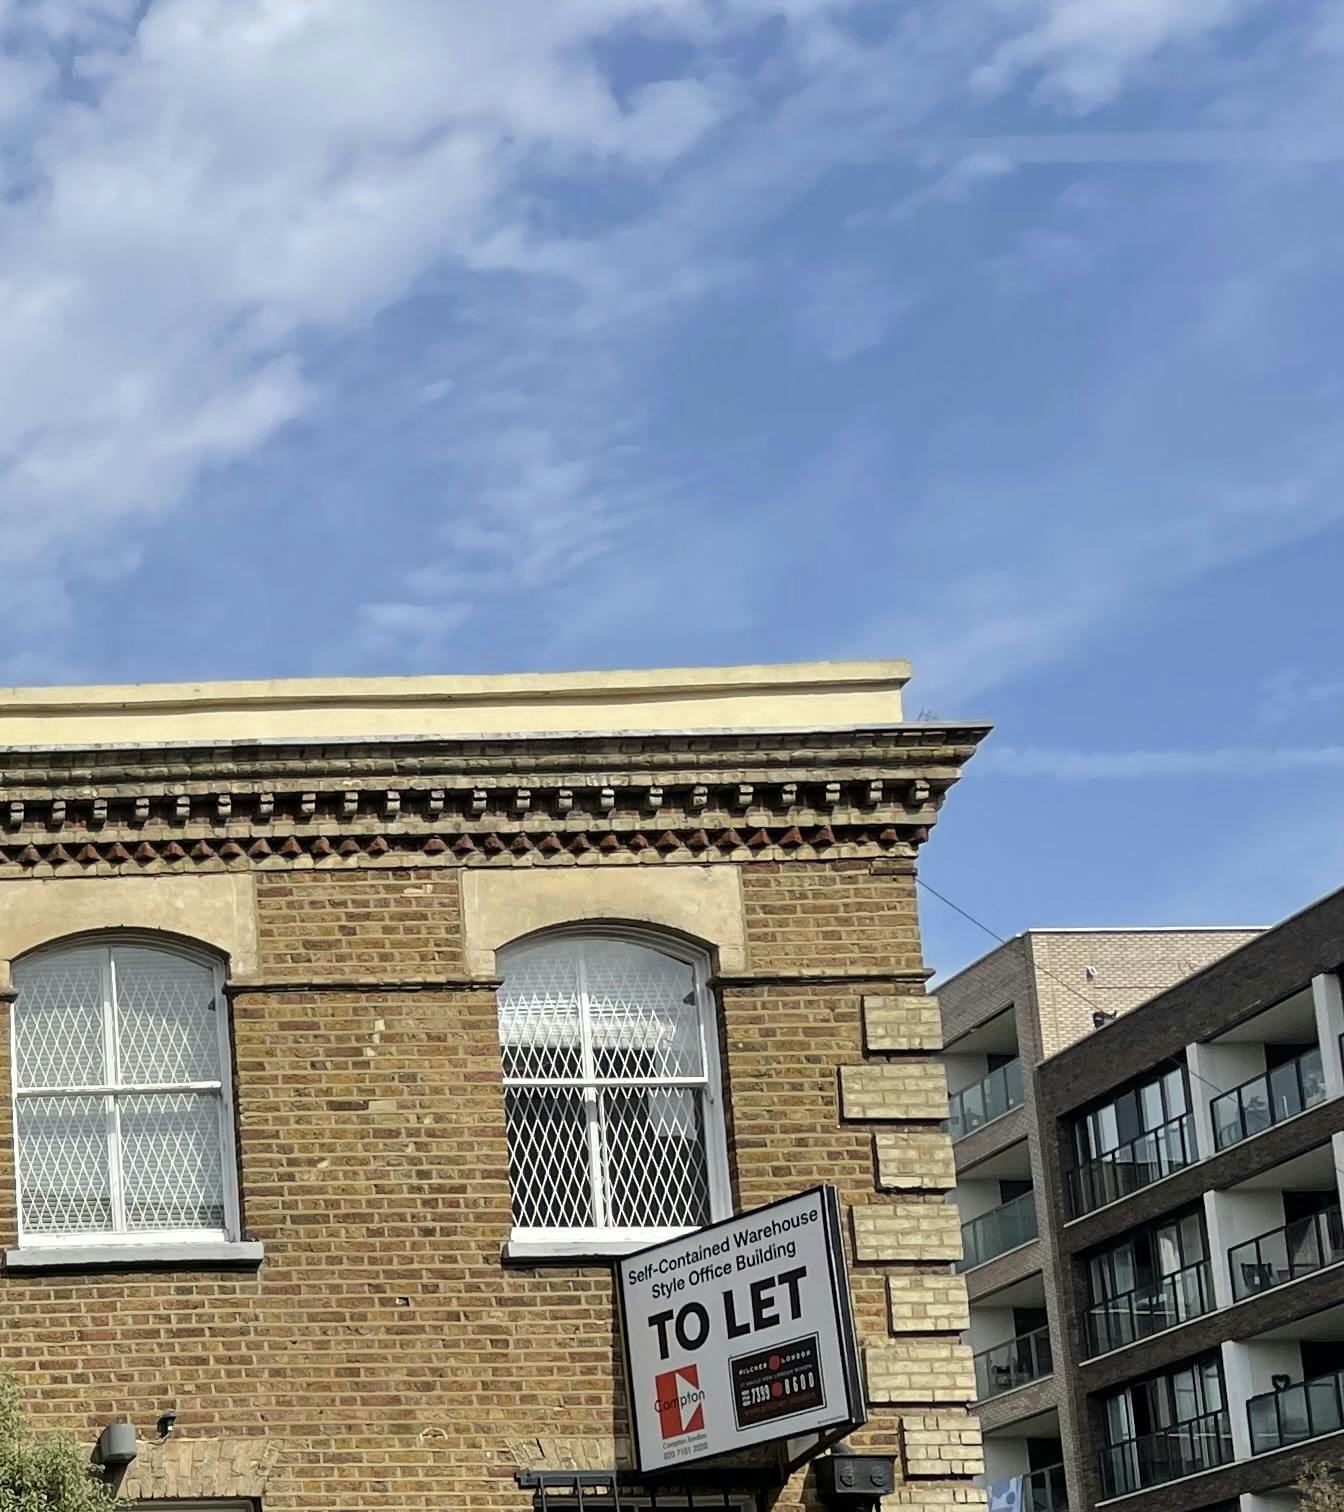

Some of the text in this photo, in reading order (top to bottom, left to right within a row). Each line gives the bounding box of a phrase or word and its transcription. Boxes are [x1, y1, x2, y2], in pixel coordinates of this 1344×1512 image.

[628, 1209, 818, 1285] Self-Contained Warehouse
[652, 1240, 796, 1299] Style Office Building
[648, 1265, 807, 1360] TO LET
[654, 1390, 705, 1413] Compton
